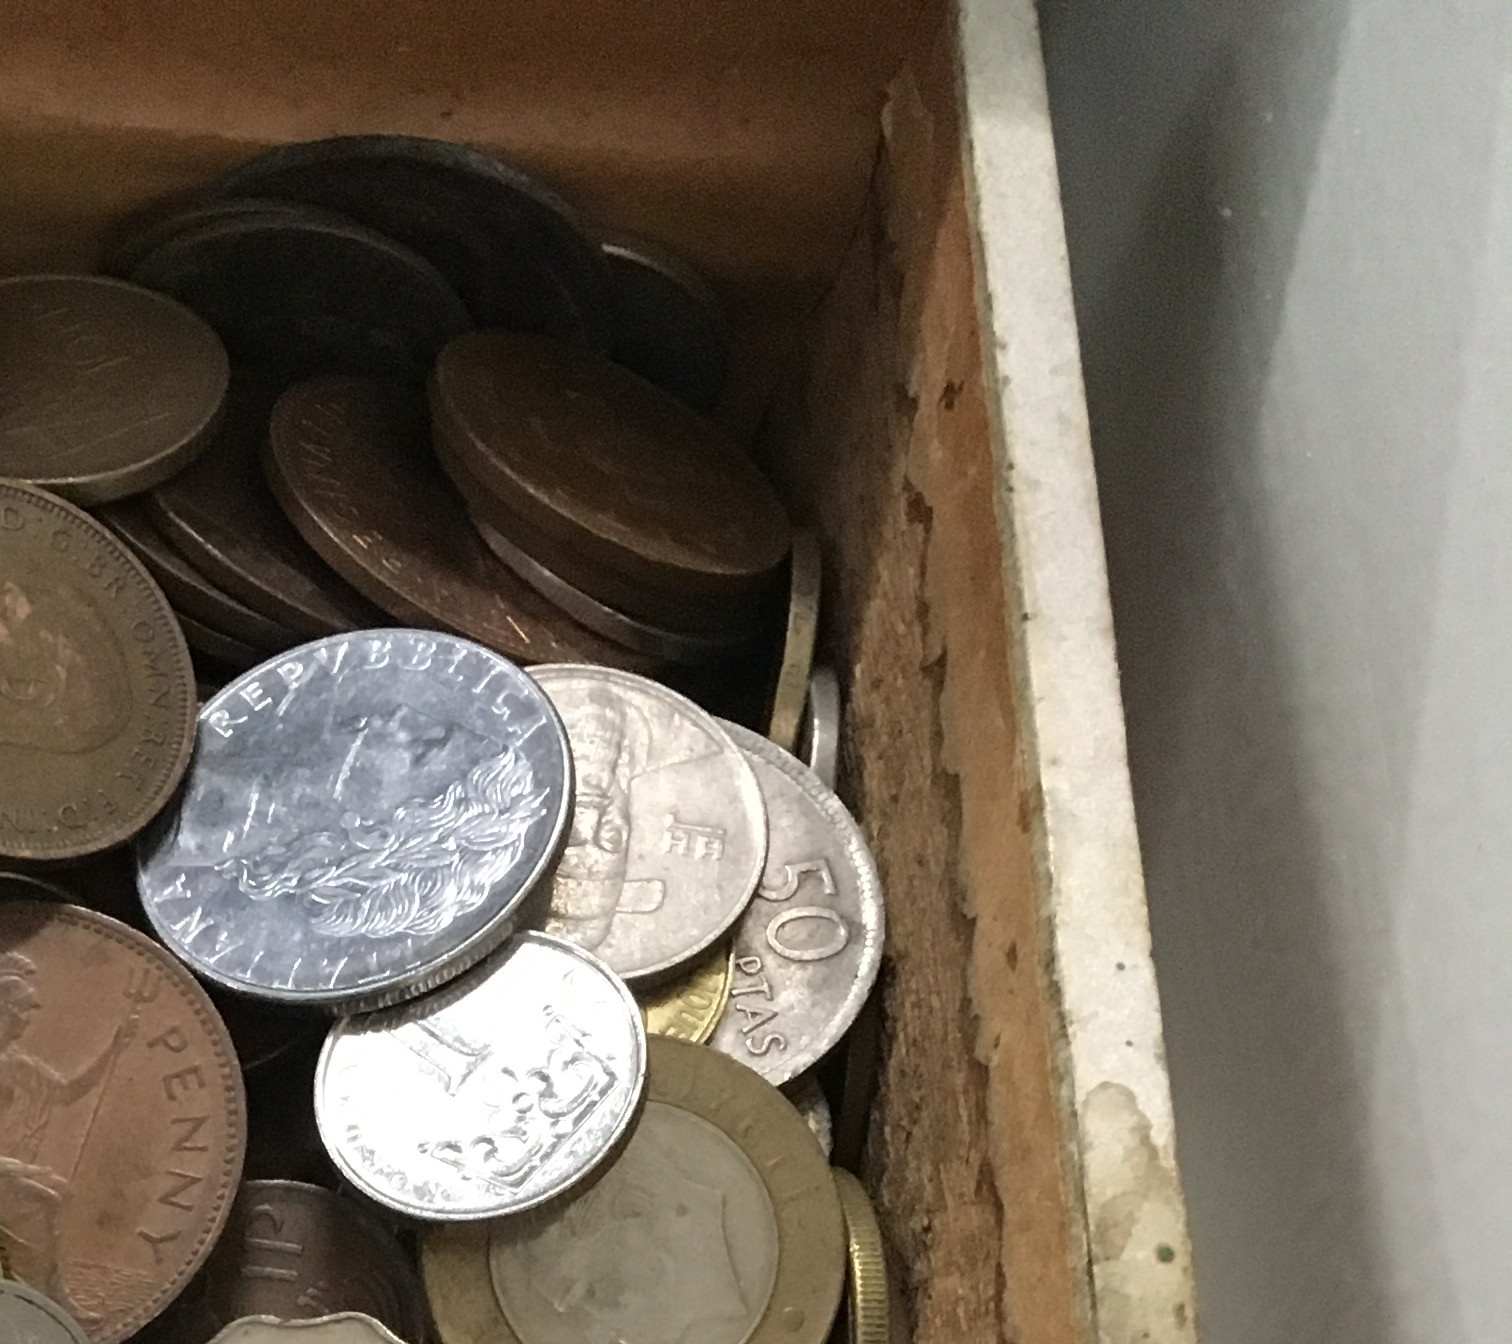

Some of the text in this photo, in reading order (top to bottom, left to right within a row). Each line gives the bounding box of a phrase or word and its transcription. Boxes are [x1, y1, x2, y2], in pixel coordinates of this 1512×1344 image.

[759, 857, 849, 962] 50
[730, 953, 788, 1058] PTAS
[134, 1022, 210, 1265] PENNY
